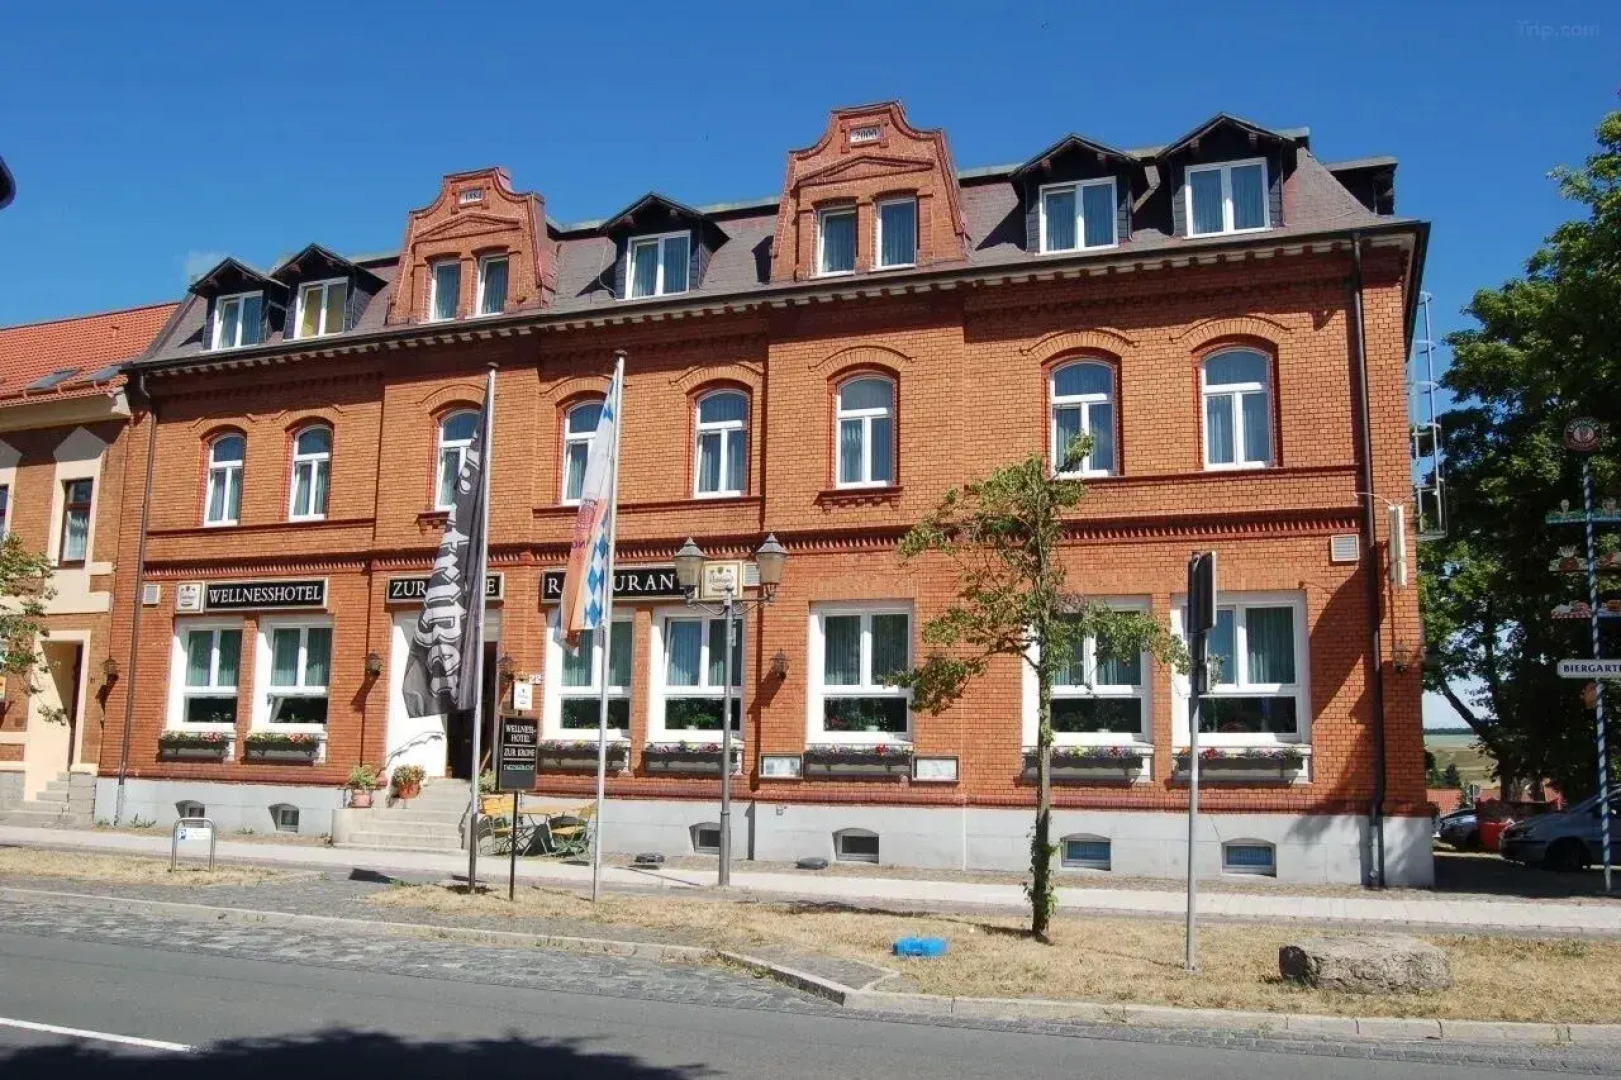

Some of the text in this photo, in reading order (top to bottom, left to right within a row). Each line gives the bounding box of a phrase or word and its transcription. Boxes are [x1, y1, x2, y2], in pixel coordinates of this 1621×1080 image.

[392, 580, 427, 597] ZUR
[547, 573, 678, 593] RURAN
[209, 586, 321, 604] WELLNESSHOTEL
[511, 734, 531, 743] HOTEL
[504, 748, 516, 756] ZUR
